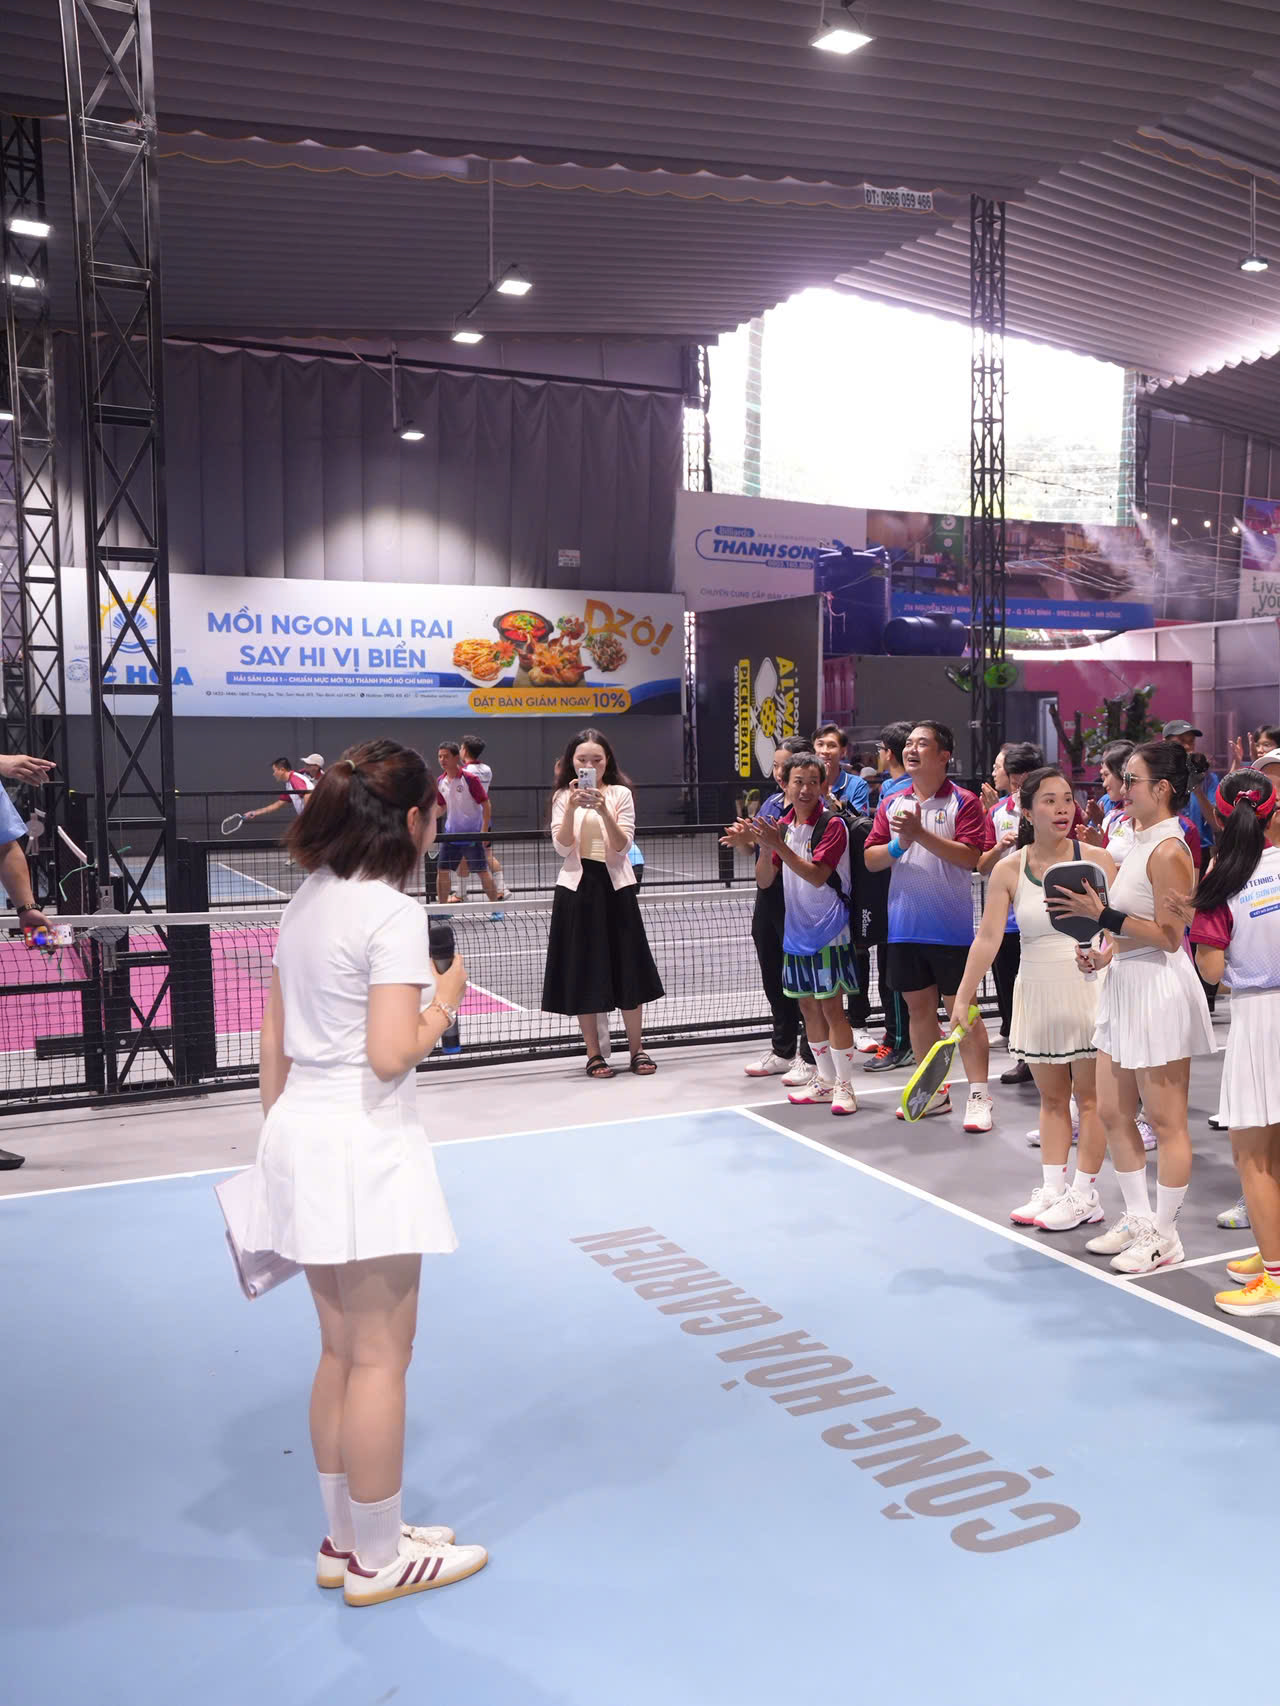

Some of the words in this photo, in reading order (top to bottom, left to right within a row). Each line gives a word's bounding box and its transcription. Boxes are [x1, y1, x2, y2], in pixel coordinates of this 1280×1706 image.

[713, 539, 774, 556] THANH
[207, 605, 262, 634] MỒI
[271, 614, 353, 637] NGON
[362, 618, 402, 638] LAI
[411, 619, 452, 639] RAI
[240, 645, 291, 667] SAY
[299, 646, 325, 667] HI
[332, 647, 360, 673] VỊ
[368, 640, 426, 669] BIỂN
[498, 694, 523, 707] BÀN
[560, 697, 590, 706] NGAY
[593, 693, 626, 708] 10%
[776, 656, 794, 737] ALWA
[740, 666, 749, 769] PICKLEBALL
[1249, 875, 1274, 888] TENNIS
[568, 1226, 783, 1336] GARDEN
[820, 1407, 1081, 1554] CỘNG
